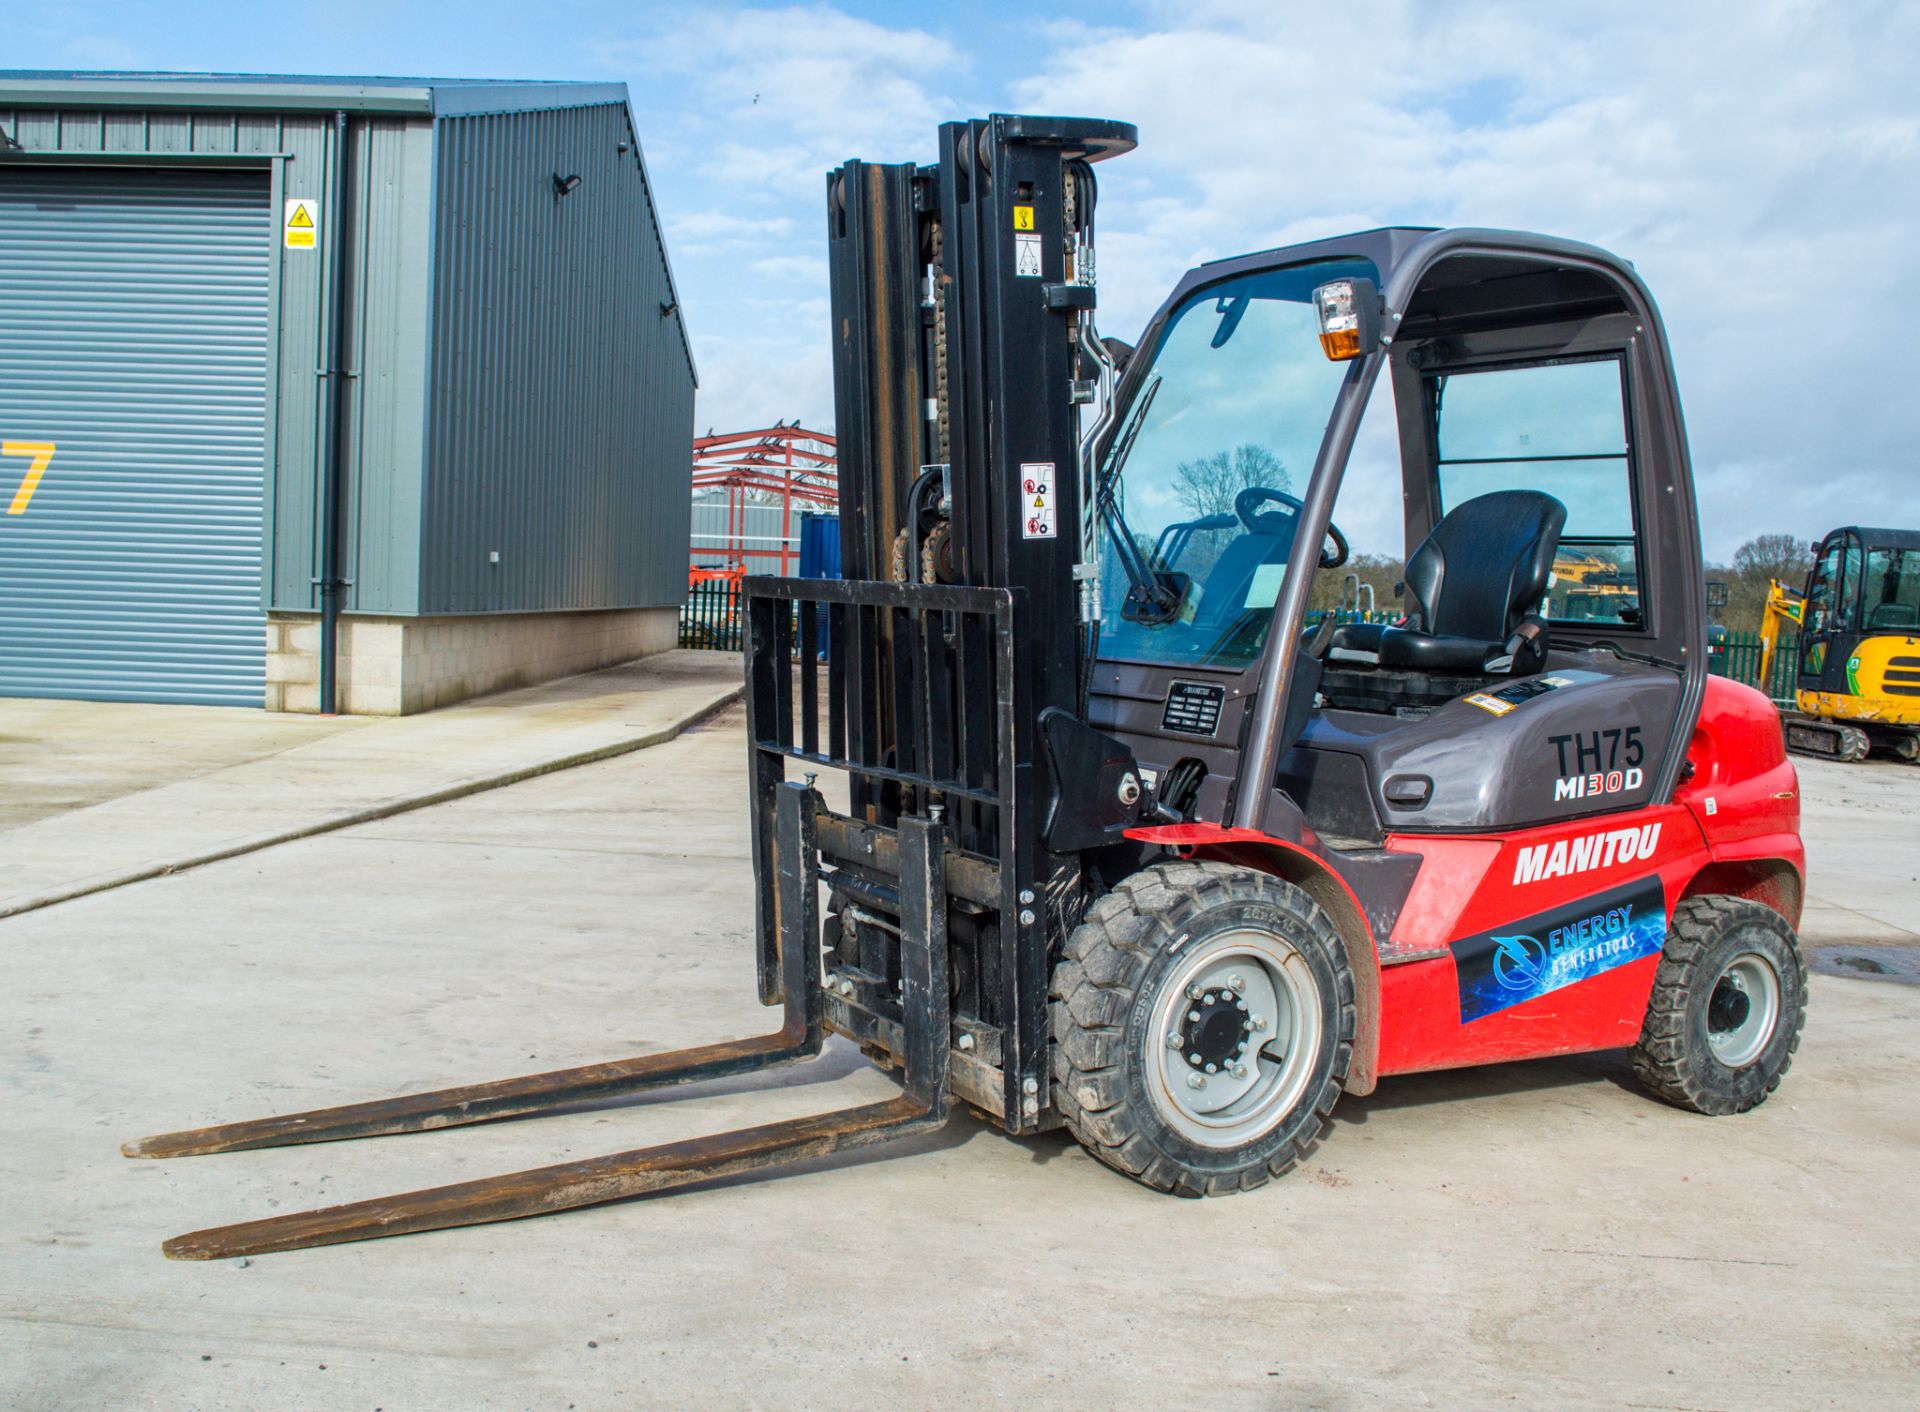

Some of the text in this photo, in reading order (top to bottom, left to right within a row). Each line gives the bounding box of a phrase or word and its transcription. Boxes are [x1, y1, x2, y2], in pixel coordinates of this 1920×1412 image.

[2, 441, 56, 514] 7
[1548, 726, 1644, 776] TH75
[1554, 768, 1643, 801] MI30D
[1512, 822, 1662, 886] MANITOU
[1549, 904, 1633, 954] ENERGY
[1552, 932, 1636, 975] GENERATORS
